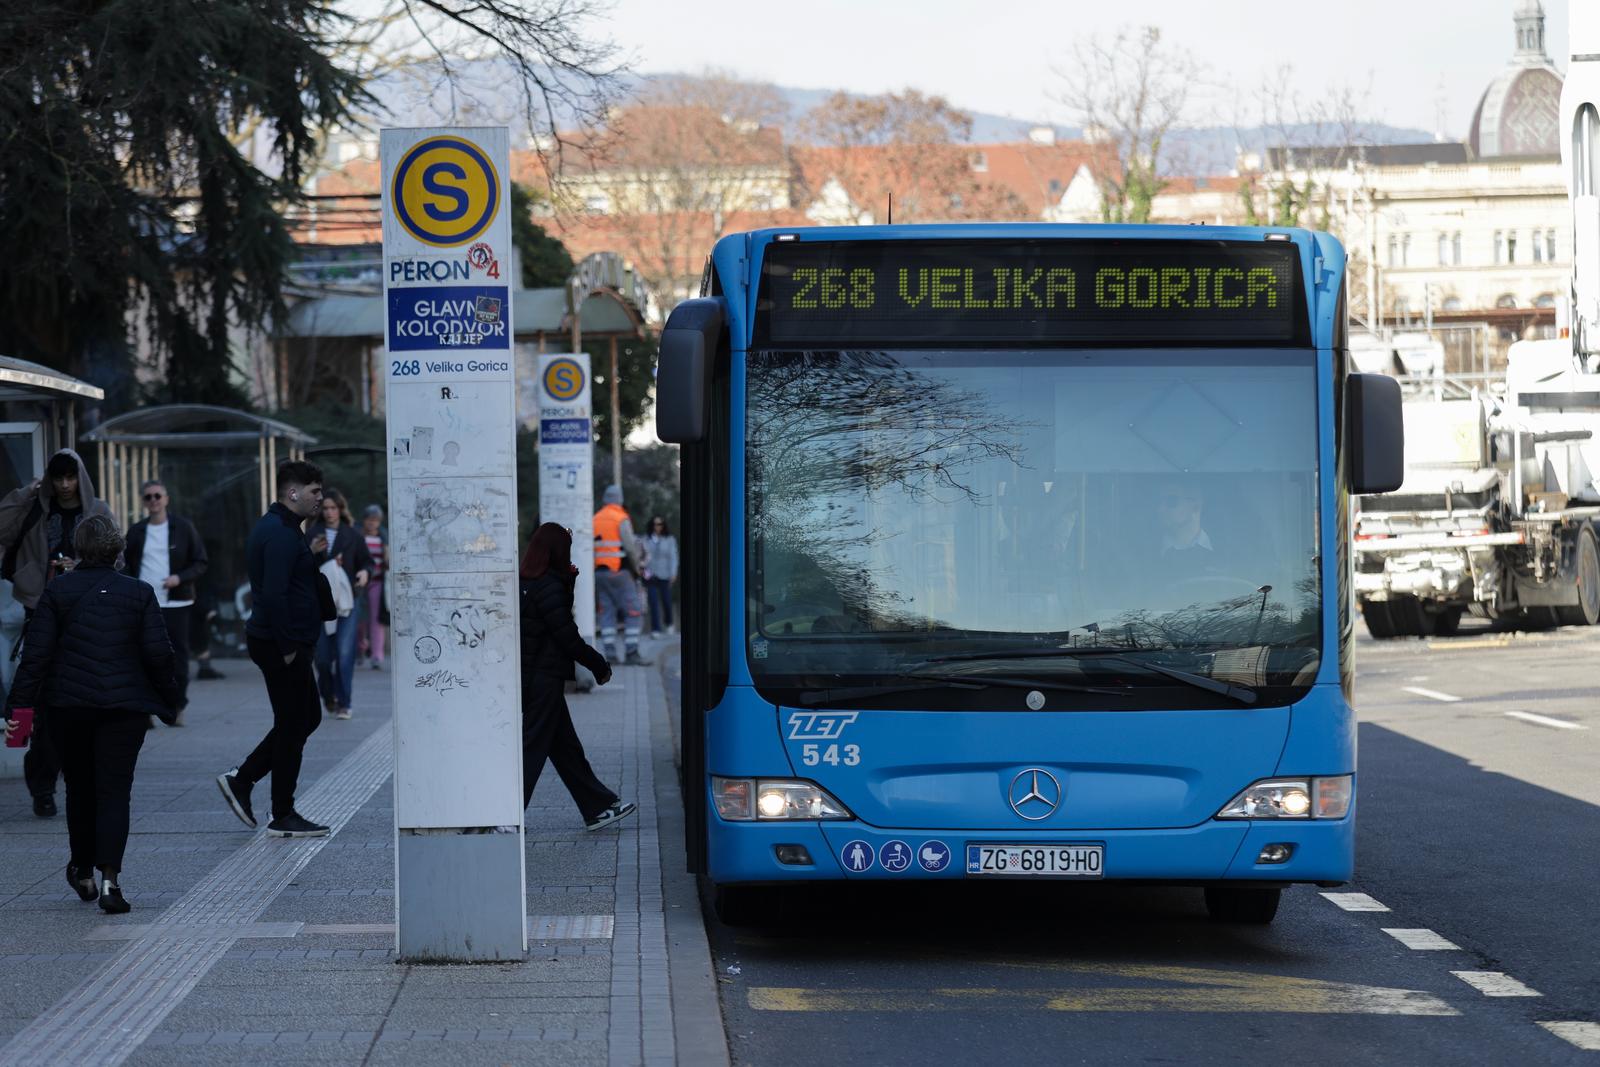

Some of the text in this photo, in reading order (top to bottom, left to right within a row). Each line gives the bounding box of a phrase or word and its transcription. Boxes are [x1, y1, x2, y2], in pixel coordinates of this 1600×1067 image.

[422, 161, 470, 222] S
[390, 260, 500, 281] PERON 4
[792, 267, 1278, 309] 268 VELIKA GORICA
[396, 319, 505, 337] KOLODVOR
[391, 360, 508, 376] 268 Velika Gorica
[554, 367, 574, 393] S
[788, 711, 859, 739] ZET
[802, 743, 861, 767] 543
[982, 849, 1007, 870] ZG
